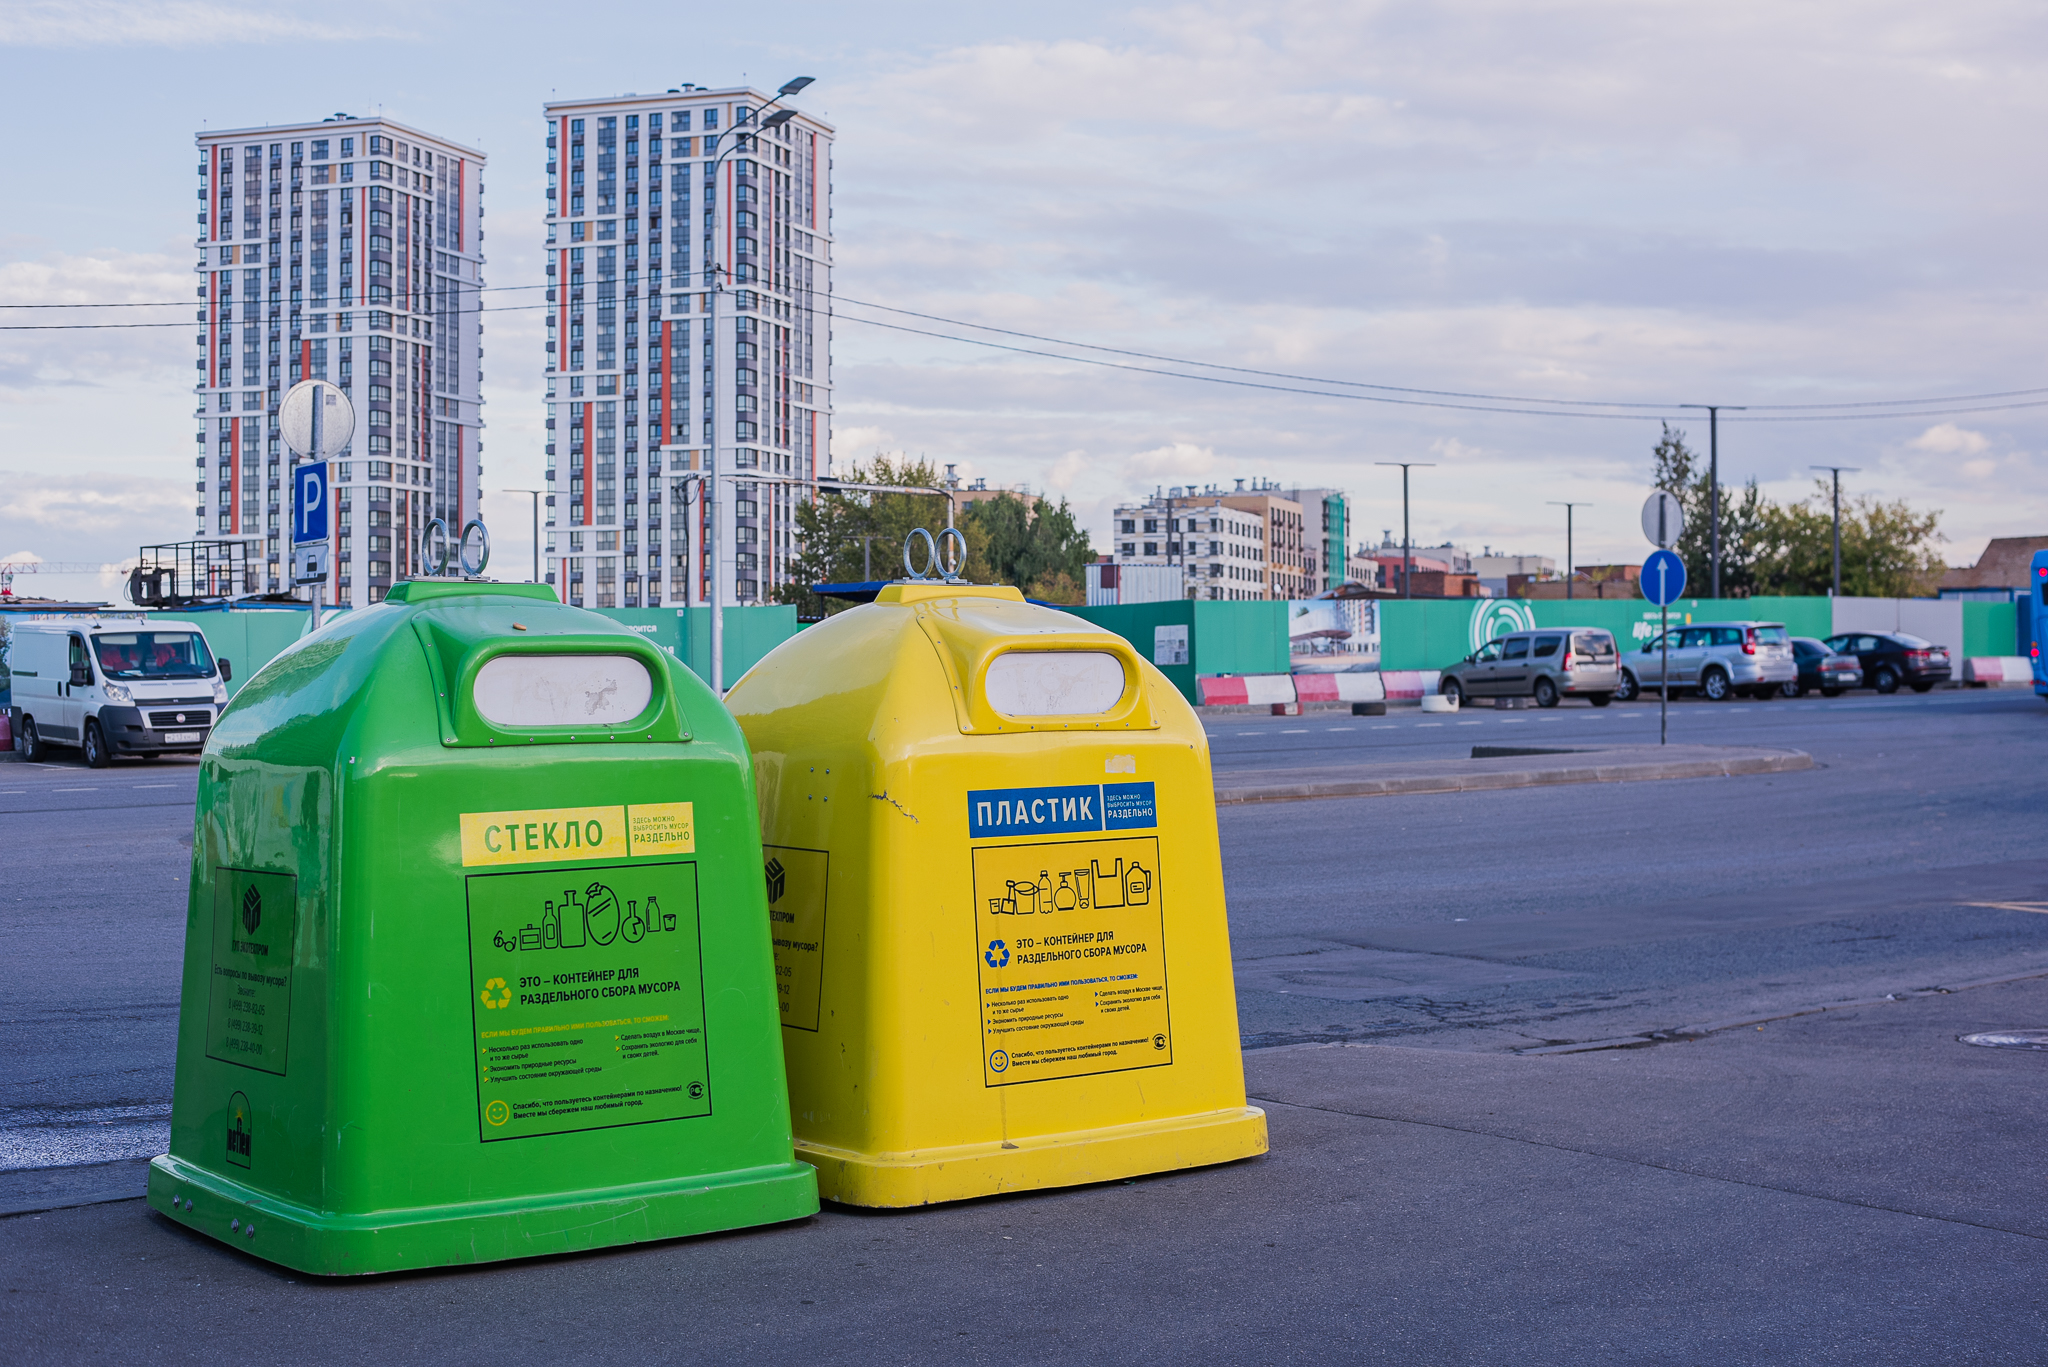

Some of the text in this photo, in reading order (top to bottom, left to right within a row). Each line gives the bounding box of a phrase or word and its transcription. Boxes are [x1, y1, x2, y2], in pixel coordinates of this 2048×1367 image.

[303, 472, 321, 534] P
[977, 796, 1093, 826] ПЛАСТИК
[1108, 808, 1153, 819] РАЗДЕЛЬНО
[485, 820, 602, 853] СТЕКЛО
[634, 831, 690, 843] РАЗДЕЛЬНО
[793, 941, 818, 953] мусора?
[1016, 938, 1034, 949] ЭТО
[1044, 932, 1094, 947] КОНТЕЙНЕР
[1096, 931, 1114, 942] ДЛЯ
[1017, 943, 1147, 965] РАЗДЕЛЬНОГО СБОРА МУСОРА
[223, 968, 241, 979] вопросы
[242, 971, 247, 980] по
[248, 972, 266, 985] вывозу
[266, 976, 287, 988] мусора?
[520, 976, 541, 988] ЭТО
[553, 970, 615, 985] КОНТЕЙНЕР
[618, 967, 639, 981] ДЛЯ
[1028, 982, 1057, 990] ПРАВИЛЬНО
[1071, 976, 1109, 985] ПОЛЬЗОВАТЬСЯ,
[521, 981, 680, 1005] РАЗДЕЛЬНОГО СБОРА МУСОРА
[511, 1028, 532, 1036] БУДЕМ
[533, 1024, 570, 1033] ПРАВИЛЬНО
[586, 1018, 632, 1028] ПОЛЬЗОВАТЬСЯ,
[1040, 1020, 1069, 1029] окружающей
[488, 1045, 519, 1053] Несколько
[531, 1040, 569, 1049] использовать
[1077, 1042, 1111, 1050] контейнерами
[1119, 1037, 1149, 1046] назначению!
[1078, 1051, 1101, 1059] любимый
[521, 1061, 552, 1070] природные
[554, 1059, 576, 1067] ресурсы
[519, 1072, 547, 1080] состояние
[548, 1067, 584, 1077] окружающей
[585, 1066, 602, 1075] среды
[513, 1101, 541, 1110] Спасибо,
[554, 1097, 592, 1106] пользуетесь
[593, 1092, 635, 1101] контейнерами
[645, 1085, 682, 1095] назначению!
[548, 1107, 579, 1115] сбережем
[594, 1101, 623, 1110] любимый
